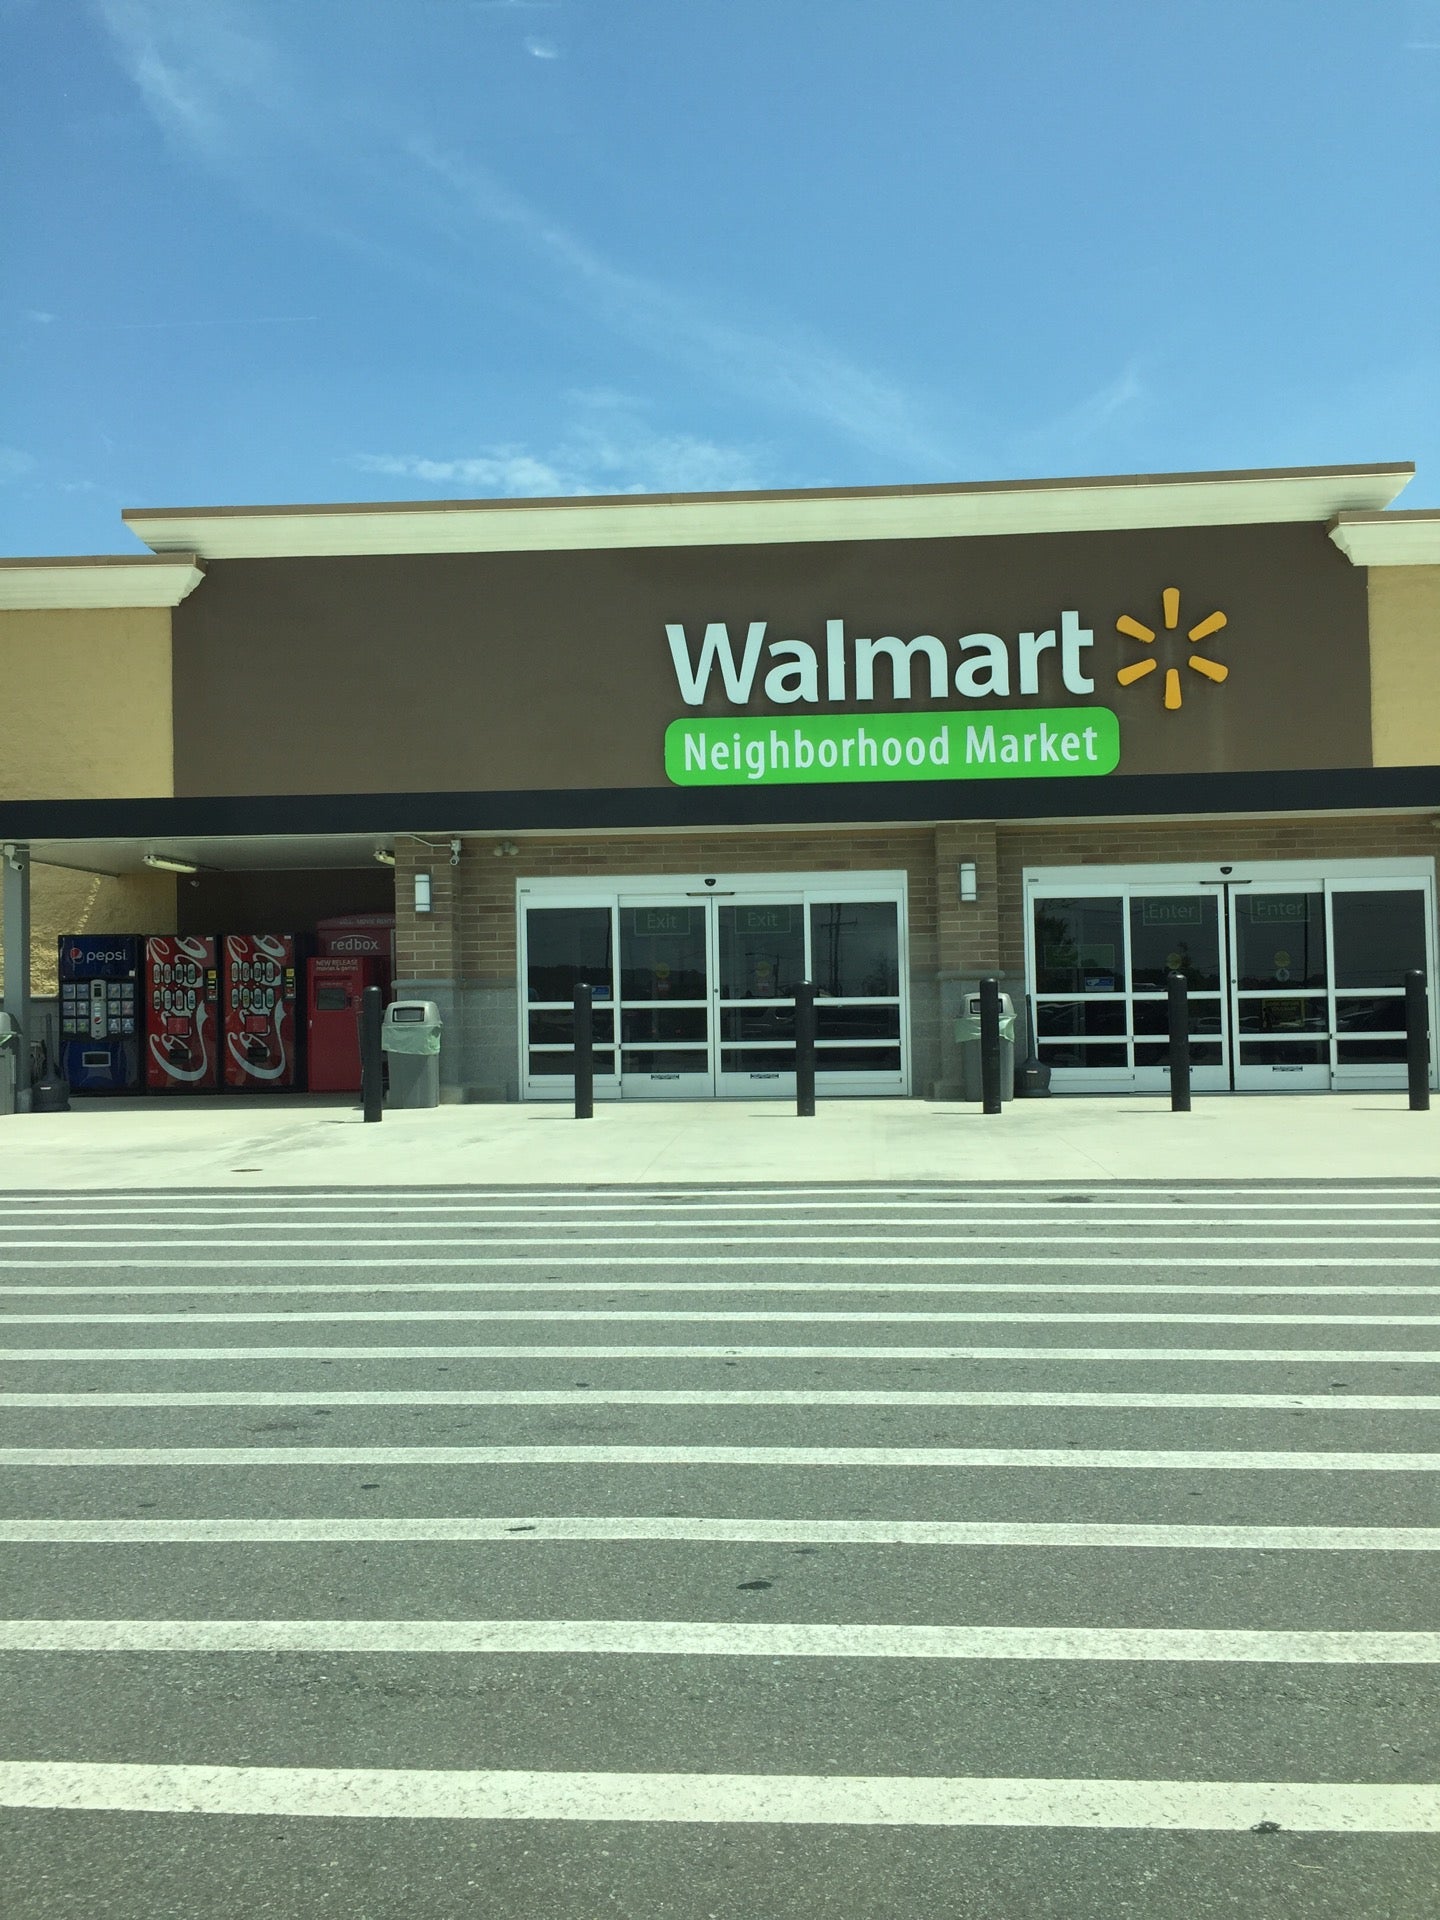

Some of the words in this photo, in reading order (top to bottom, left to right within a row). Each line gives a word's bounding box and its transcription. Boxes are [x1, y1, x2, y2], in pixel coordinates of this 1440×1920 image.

[665, 611, 1094, 706] Walmart
[684, 726, 949, 779] Neighborhood
[965, 723, 1098, 764] Market
[1149, 903, 1194, 919] Enter
[1257, 901, 1304, 916] Enter
[647, 913, 677, 929] Exit
[747, 911, 778, 927] Exit
[331, 938, 379, 950] redbox
[86, 949, 126, 964] pepsi
